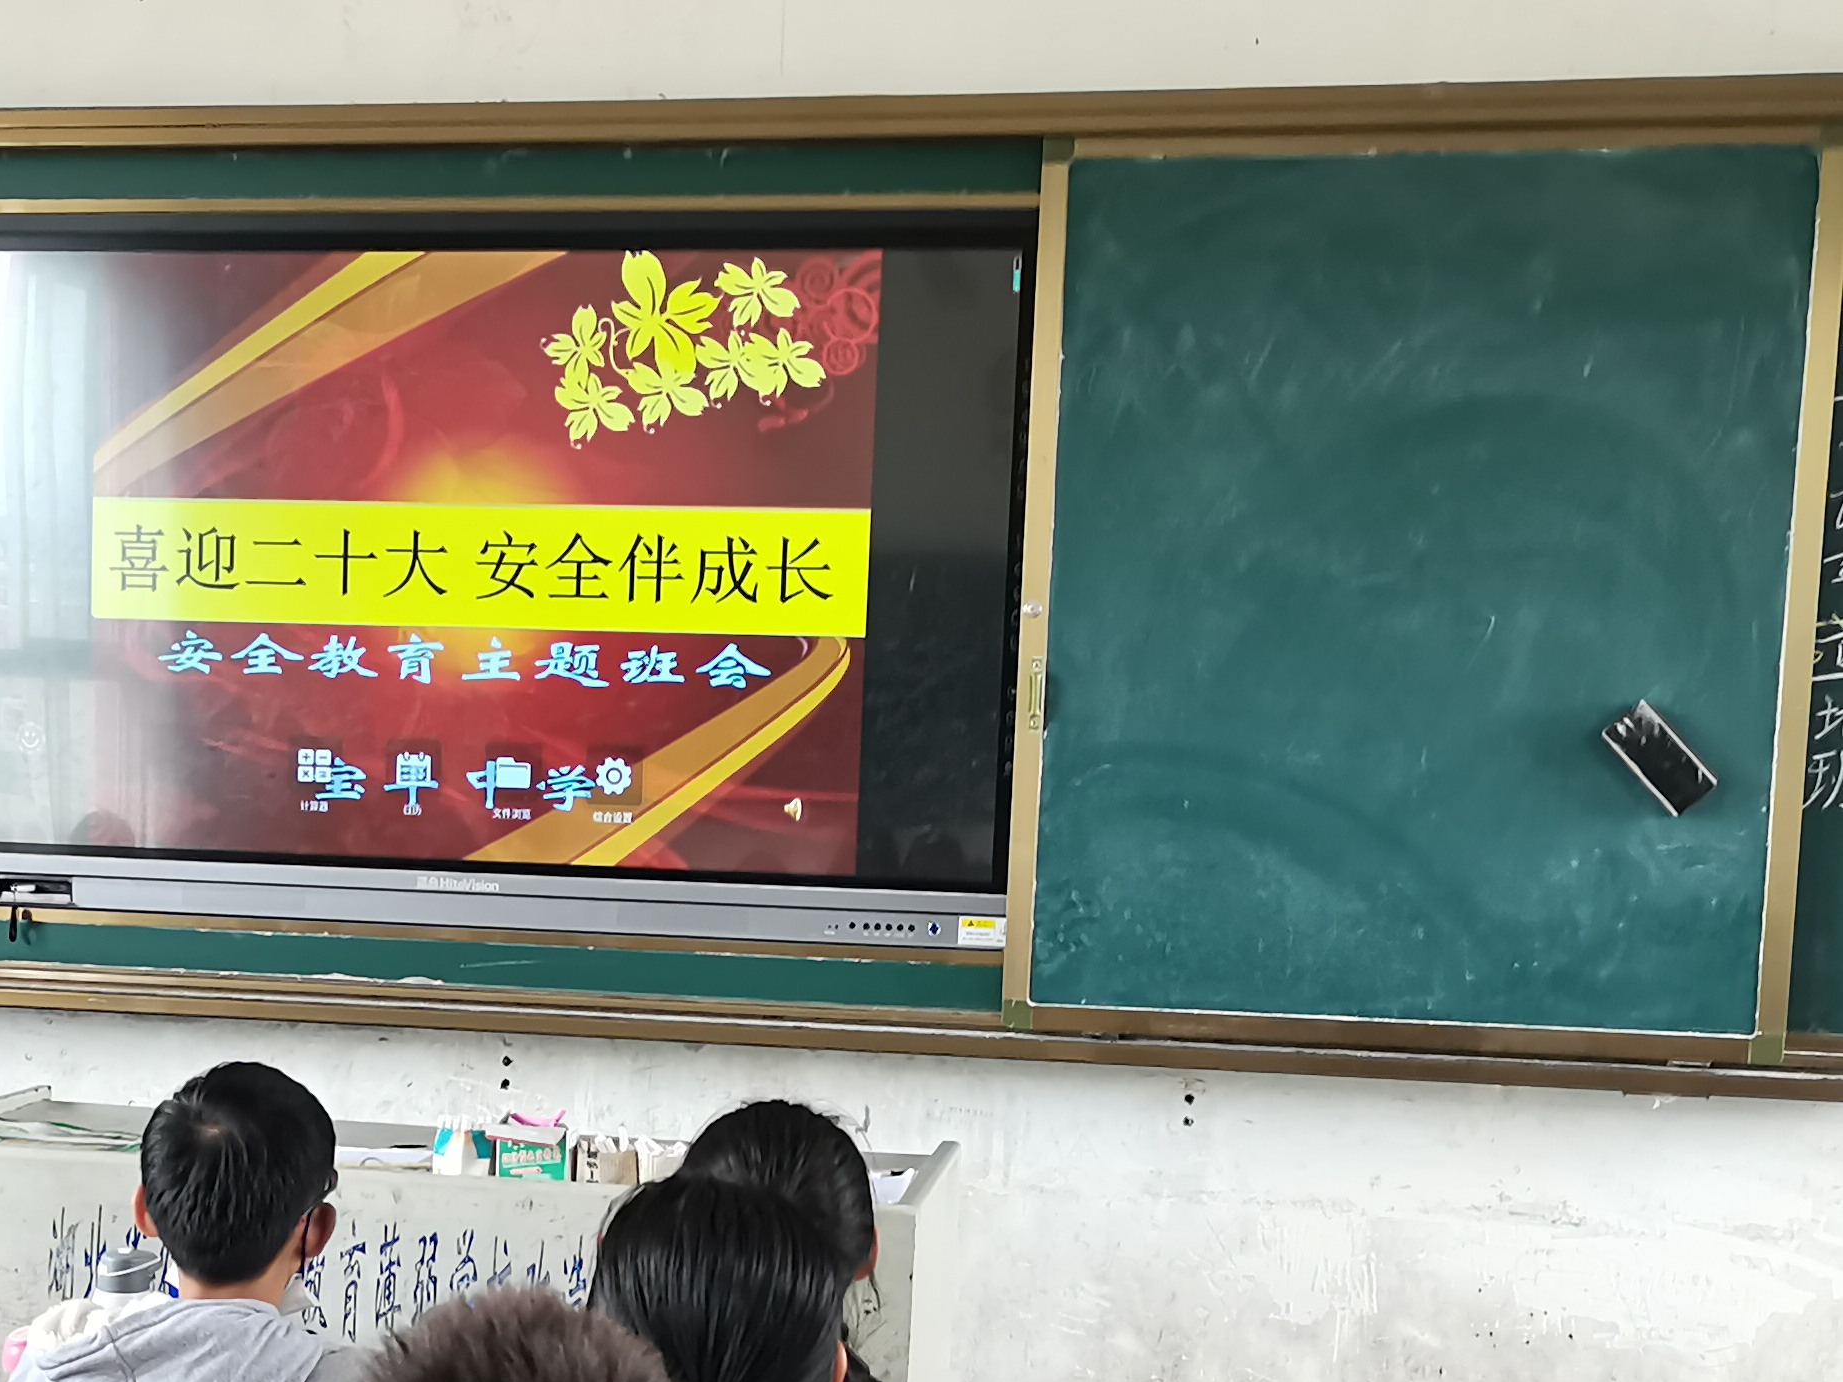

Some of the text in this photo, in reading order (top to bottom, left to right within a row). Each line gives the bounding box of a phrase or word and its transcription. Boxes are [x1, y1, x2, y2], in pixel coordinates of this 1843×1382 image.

[108, 524, 835, 606] 喜迎二十大 安全伴成长
[157, 630, 772, 690] 安全教育主题班会
